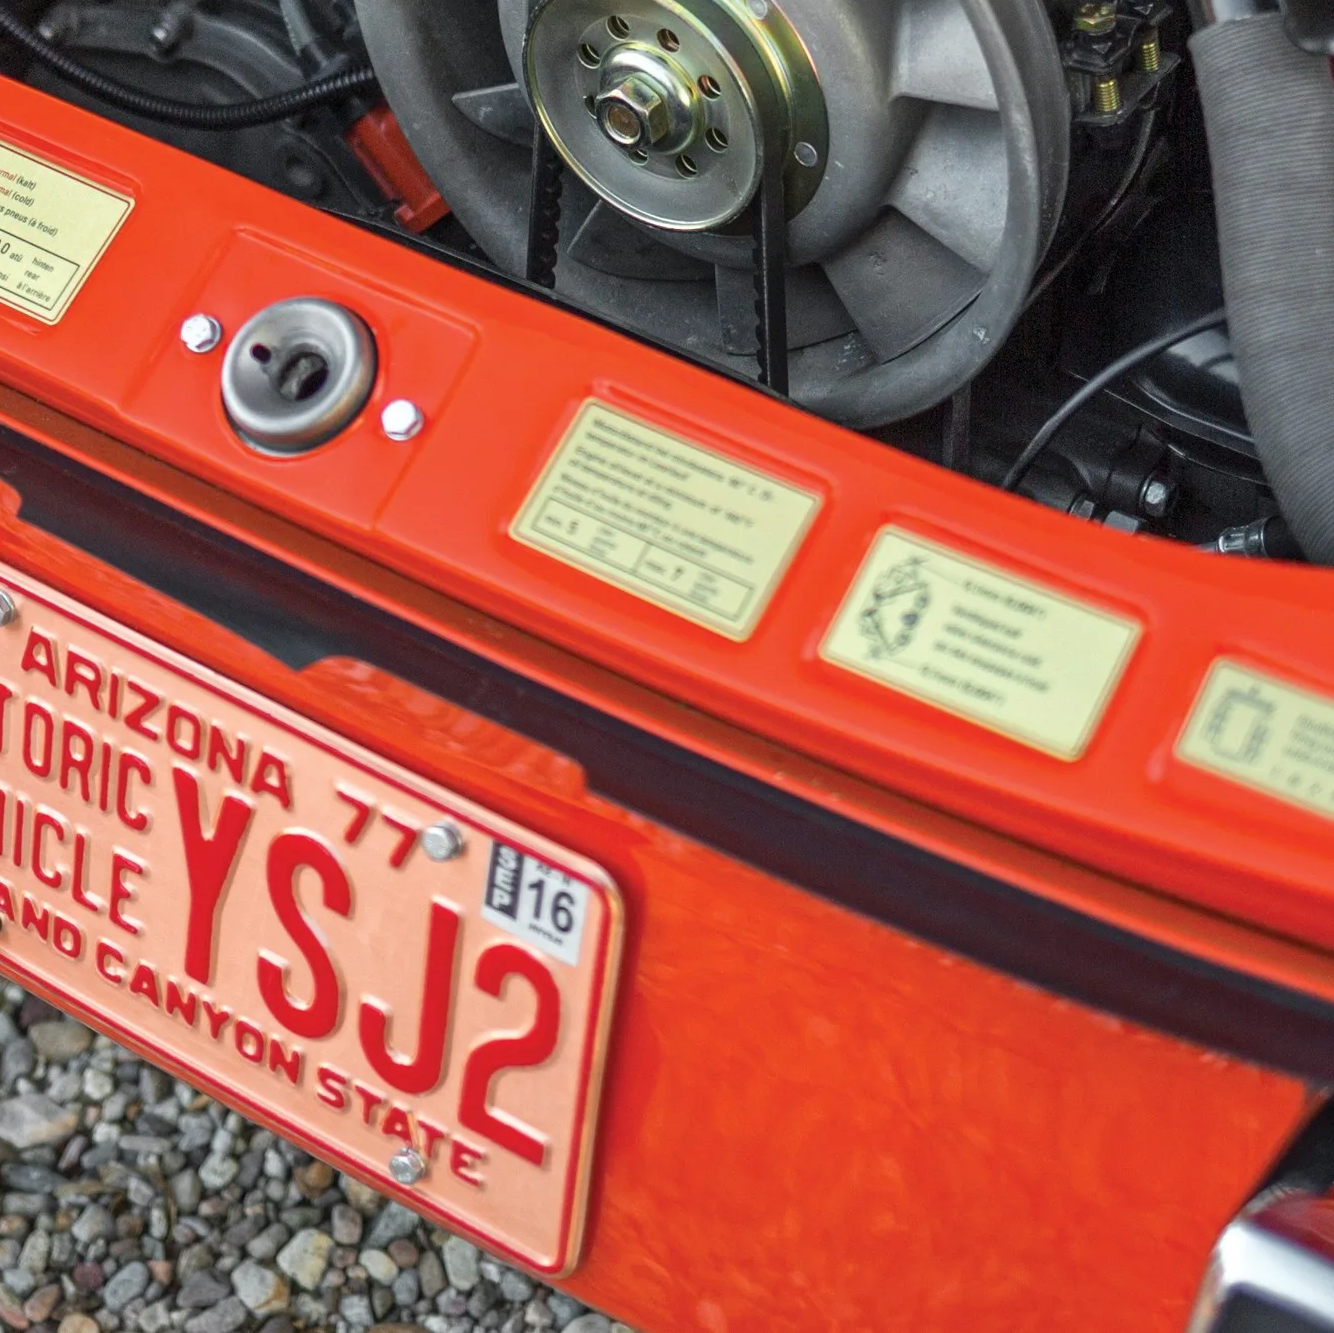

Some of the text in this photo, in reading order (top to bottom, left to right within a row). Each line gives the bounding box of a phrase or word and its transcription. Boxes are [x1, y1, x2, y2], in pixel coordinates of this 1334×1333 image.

[11, 191, 34, 206] (cold)
[16, 176, 36, 190] (kalt)
[3, 208, 28, 223] pneus
[37, 221, 58, 236] froid)
[24, 270, 39, 280] rear
[32, 257, 53, 272] hinten
[20, 627, 294, 809] ARIZONA
[337, 789, 419, 869] 77
[491, 845, 518, 911] SEP
[527, 878, 576, 935] 16
[173, 766, 561, 1169] YSJ2
[95, 942, 302, 1085] CANYON
[315, 1064, 486, 1187] STATE
